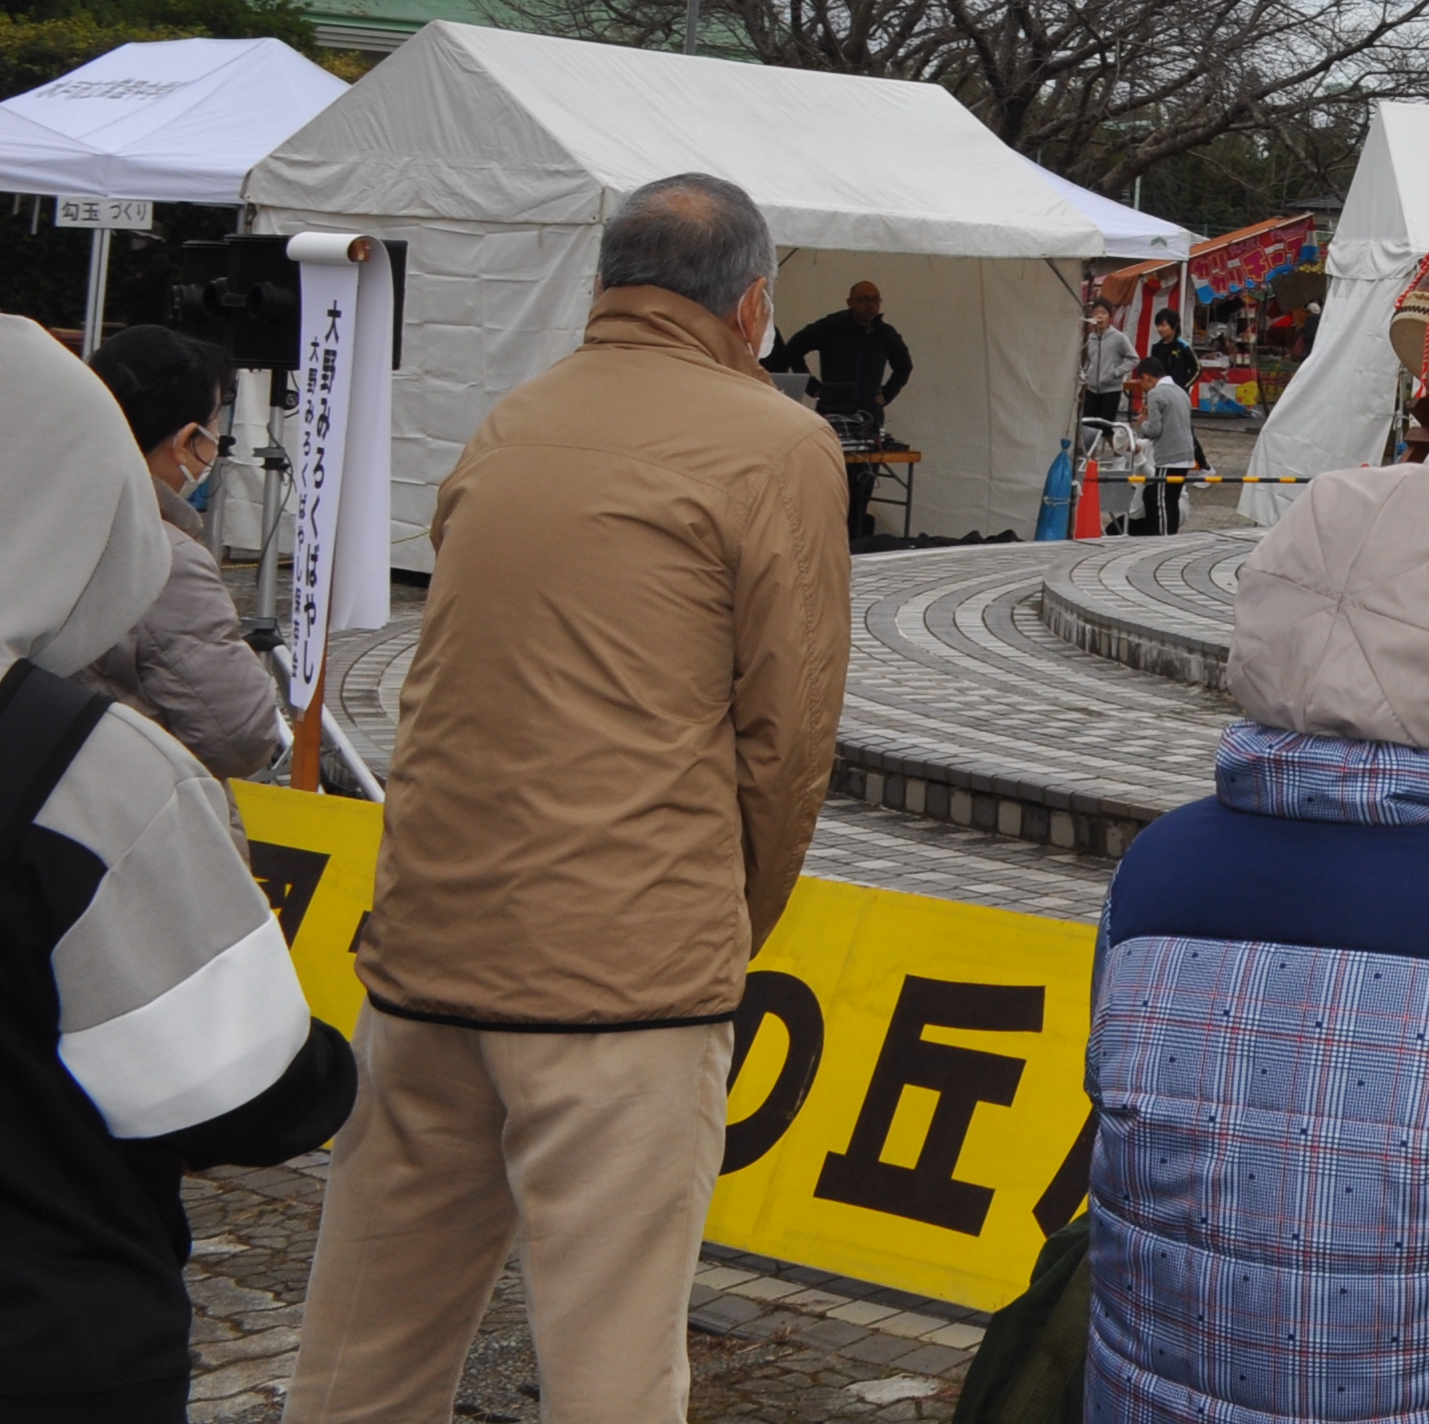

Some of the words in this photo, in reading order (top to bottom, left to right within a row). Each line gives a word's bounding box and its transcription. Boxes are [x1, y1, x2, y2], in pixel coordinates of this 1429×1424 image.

[109, 202, 147, 221] づくり
[302, 300, 342, 685] 大野みろくばやし
